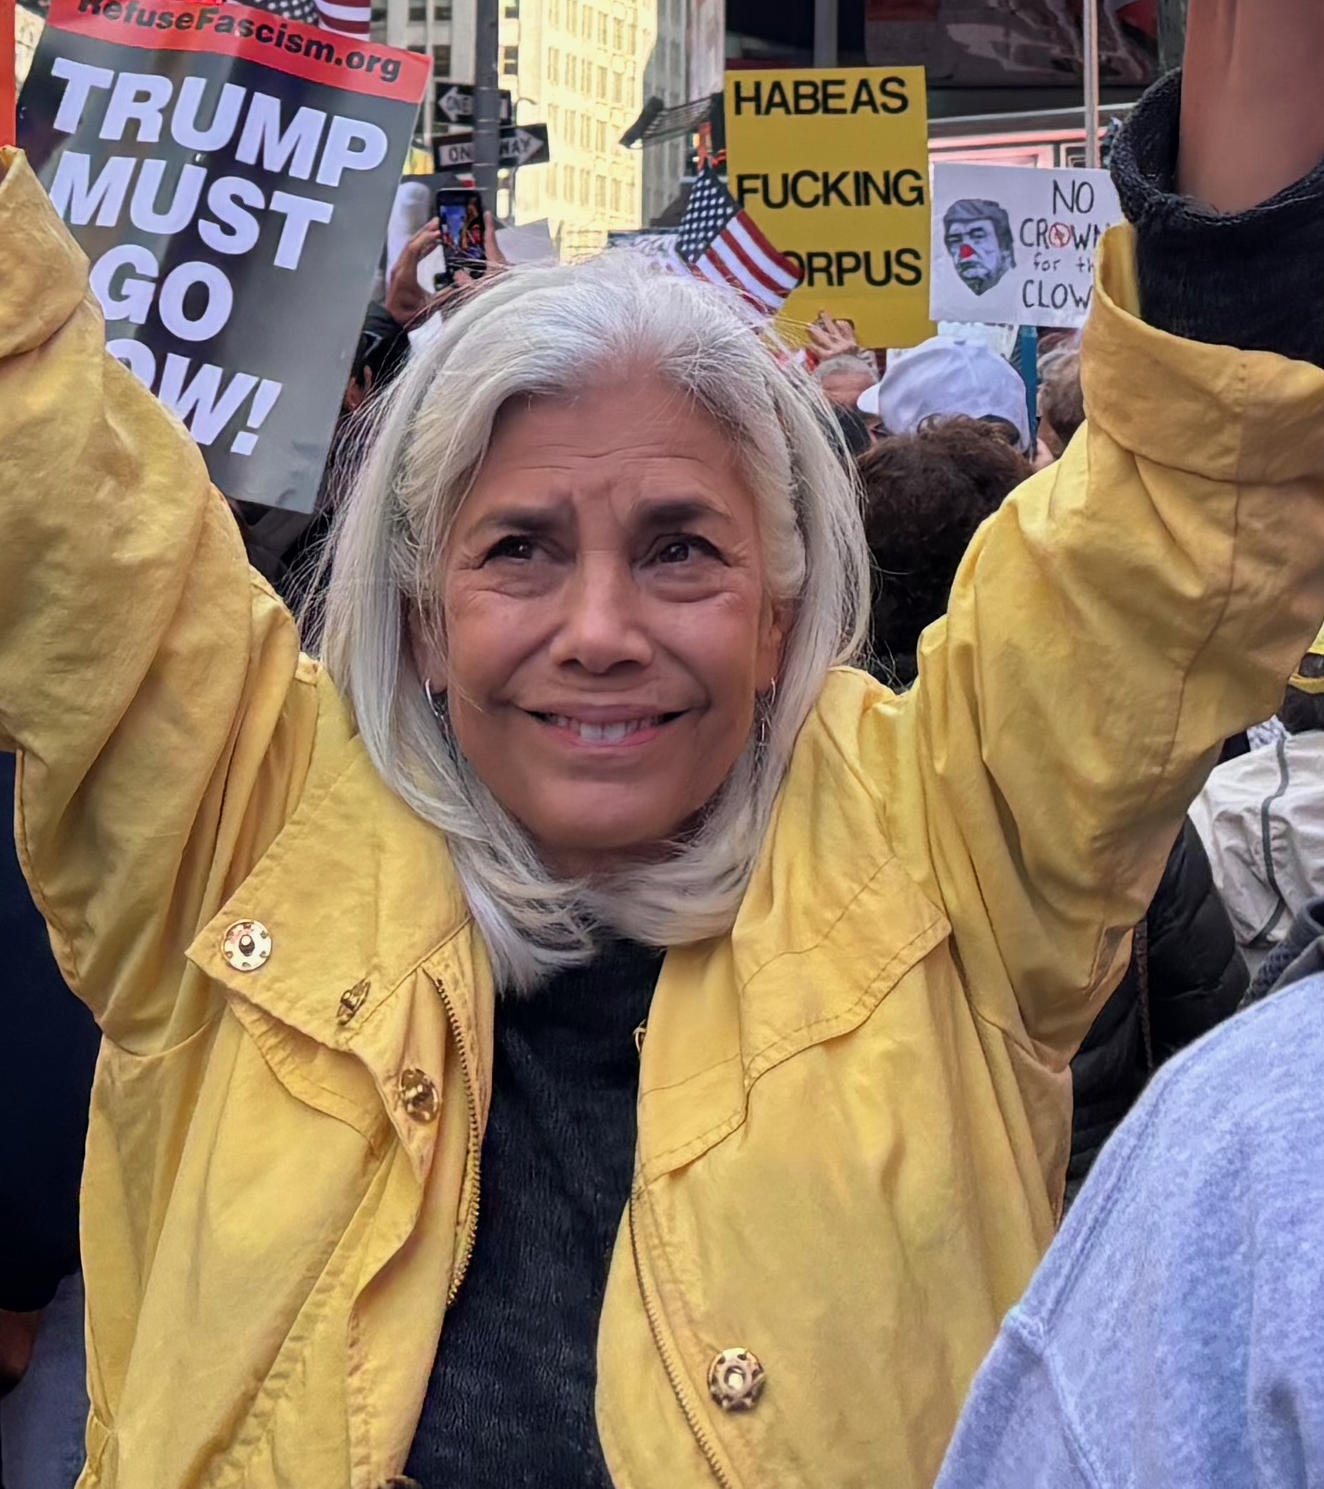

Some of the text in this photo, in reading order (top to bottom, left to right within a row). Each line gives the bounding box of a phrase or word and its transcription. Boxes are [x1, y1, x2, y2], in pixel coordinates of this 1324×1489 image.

[733, 75, 910, 116] HABEAS
[51, 56, 389, 189] TRUMP
[735, 168, 925, 210] FUCKING
[1052, 178, 1095, 215] NO
[47, 150, 334, 272] MUST
[780, 248, 923, 289] ORPUS
[87, 243, 234, 343] GO
[1022, 279, 1093, 310] CLOW
